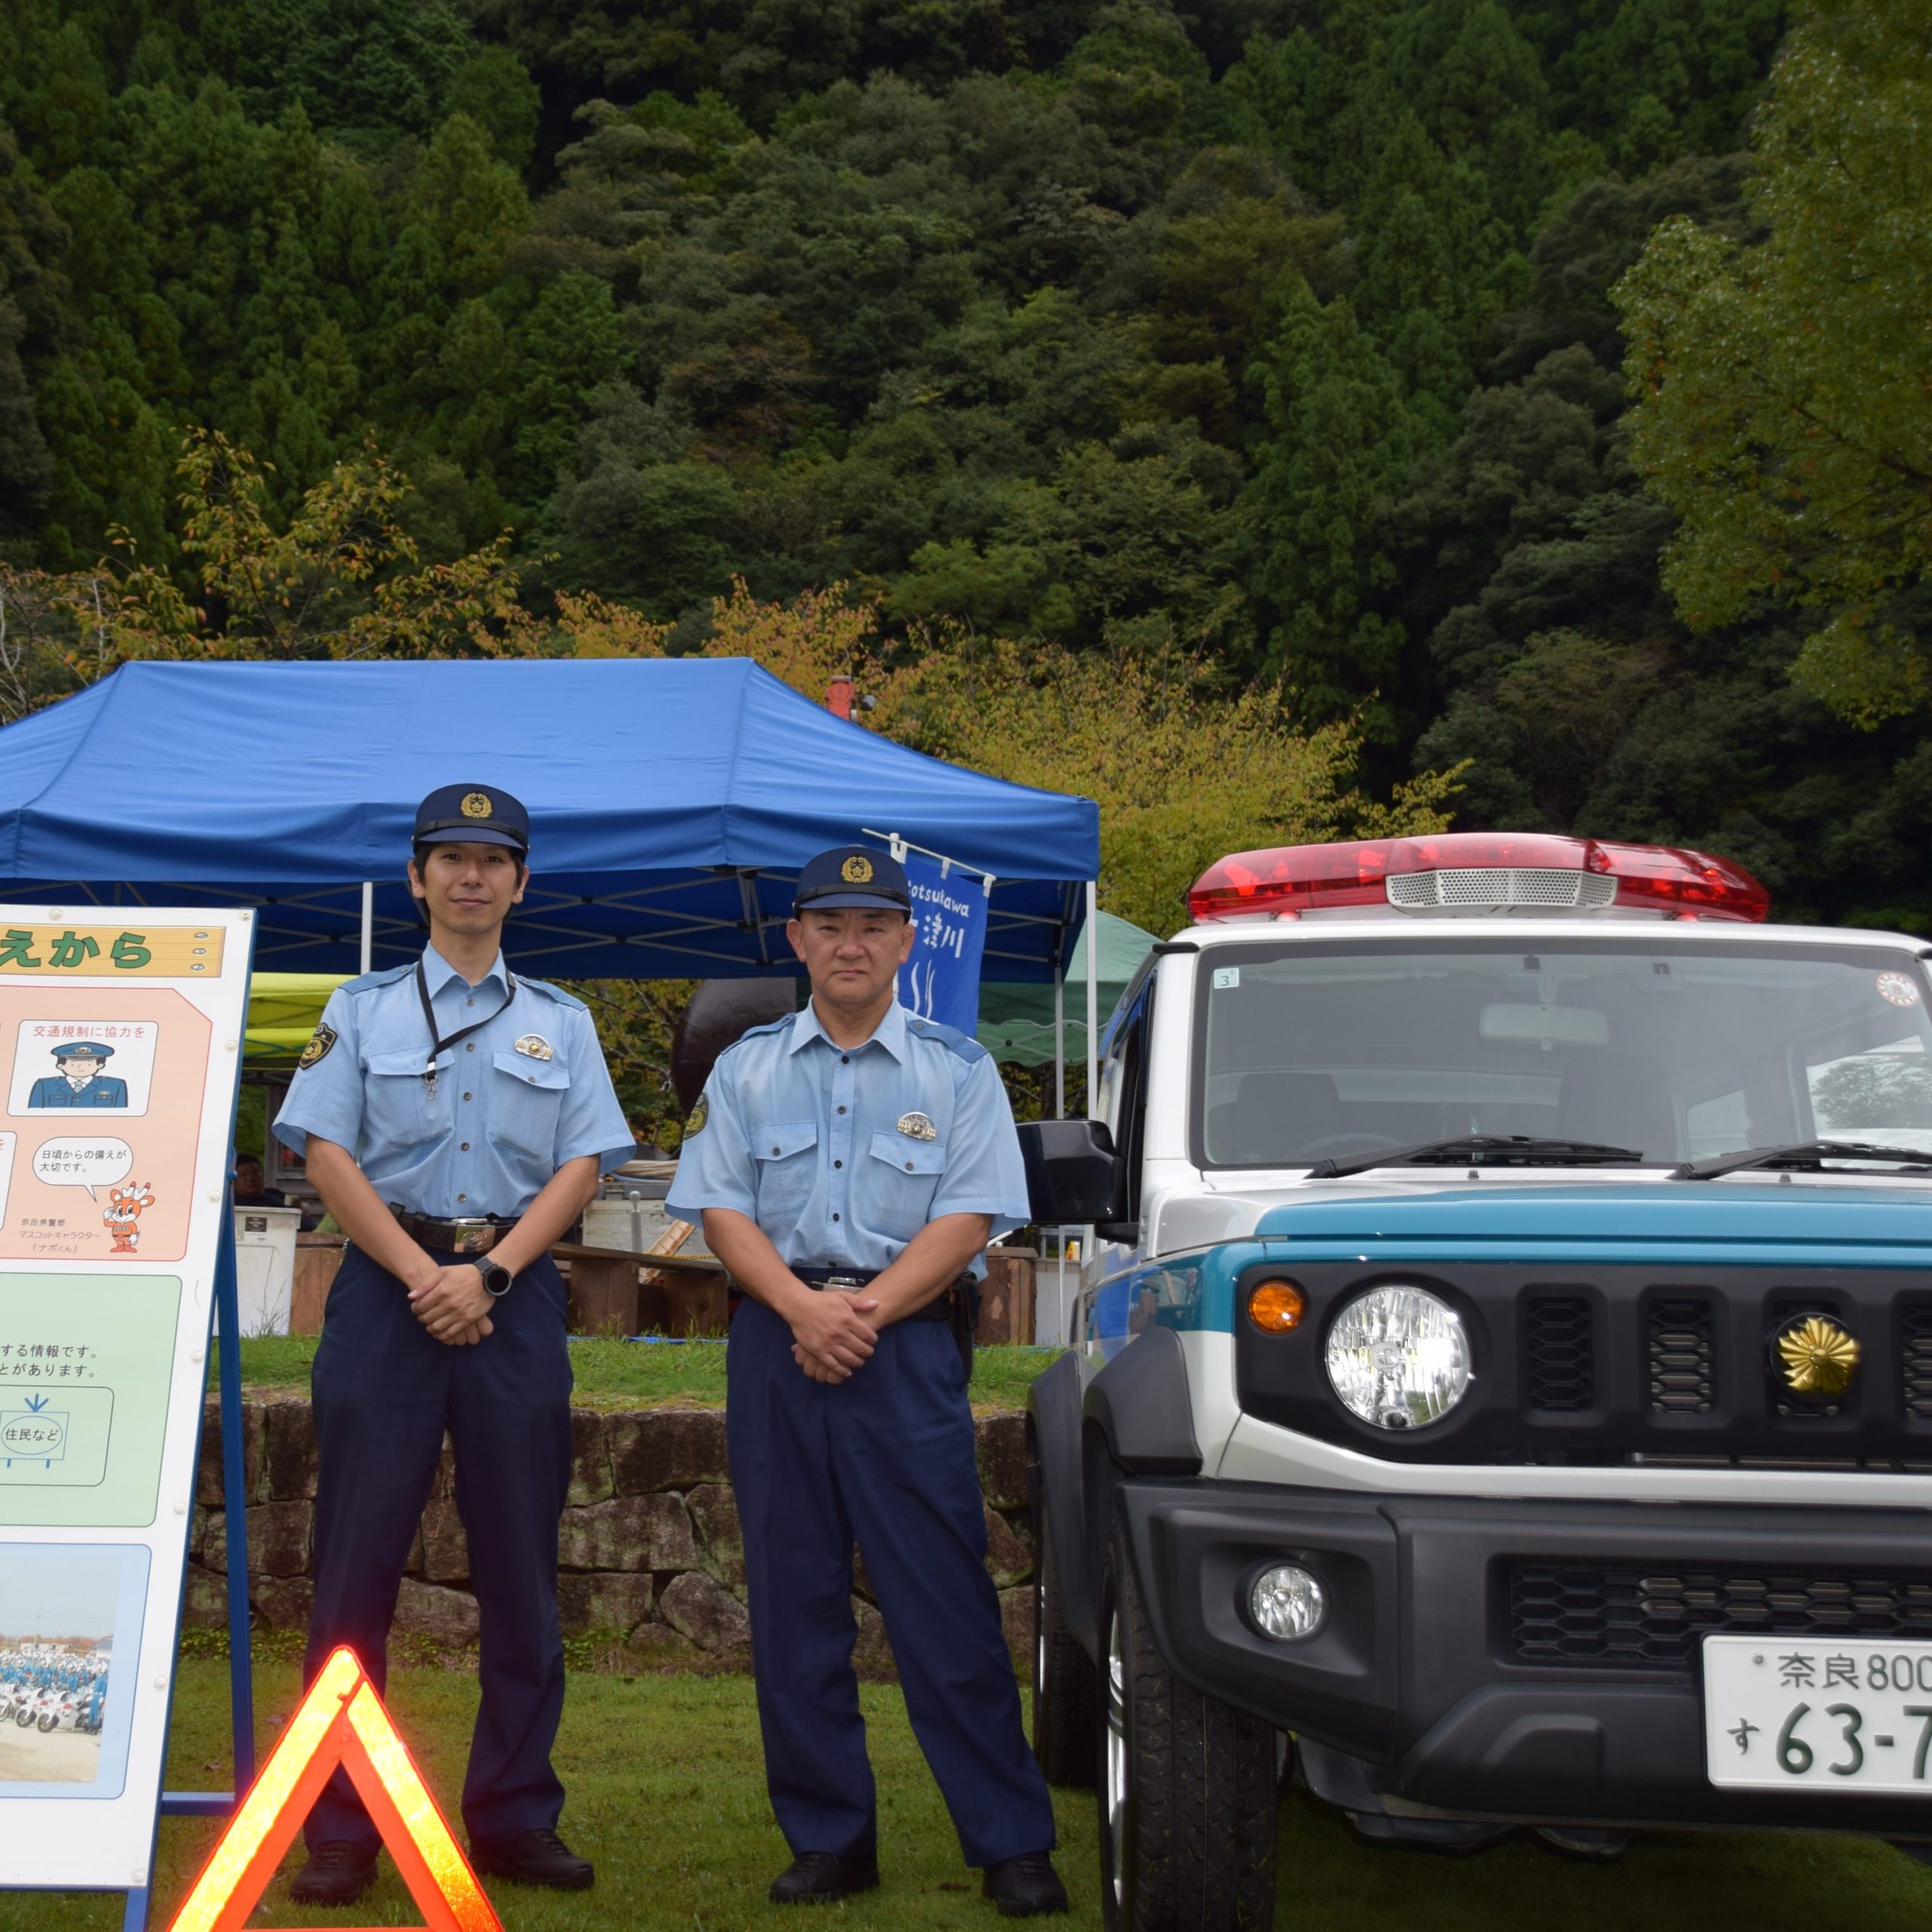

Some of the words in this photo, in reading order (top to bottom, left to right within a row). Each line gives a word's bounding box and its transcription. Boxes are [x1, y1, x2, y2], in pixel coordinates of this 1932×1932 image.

[908, 880, 969, 917] otsukawa
[0, 929, 152, 969] えから
[1220, 975, 1229, 986] 3
[33, 1026, 145, 1038] 交通規制に協力を
[42, 1149, 127, 1160] 日頃からの備えが
[39, 1162, 87, 1173] 大切です。
[20, 1231, 100, 1240] マスコットキャラクター
[1, 1343, 96, 1358] する情報です。
[0, 1363, 94, 1377] とがあります。
[5, 1428, 59, 1441] 住民など
